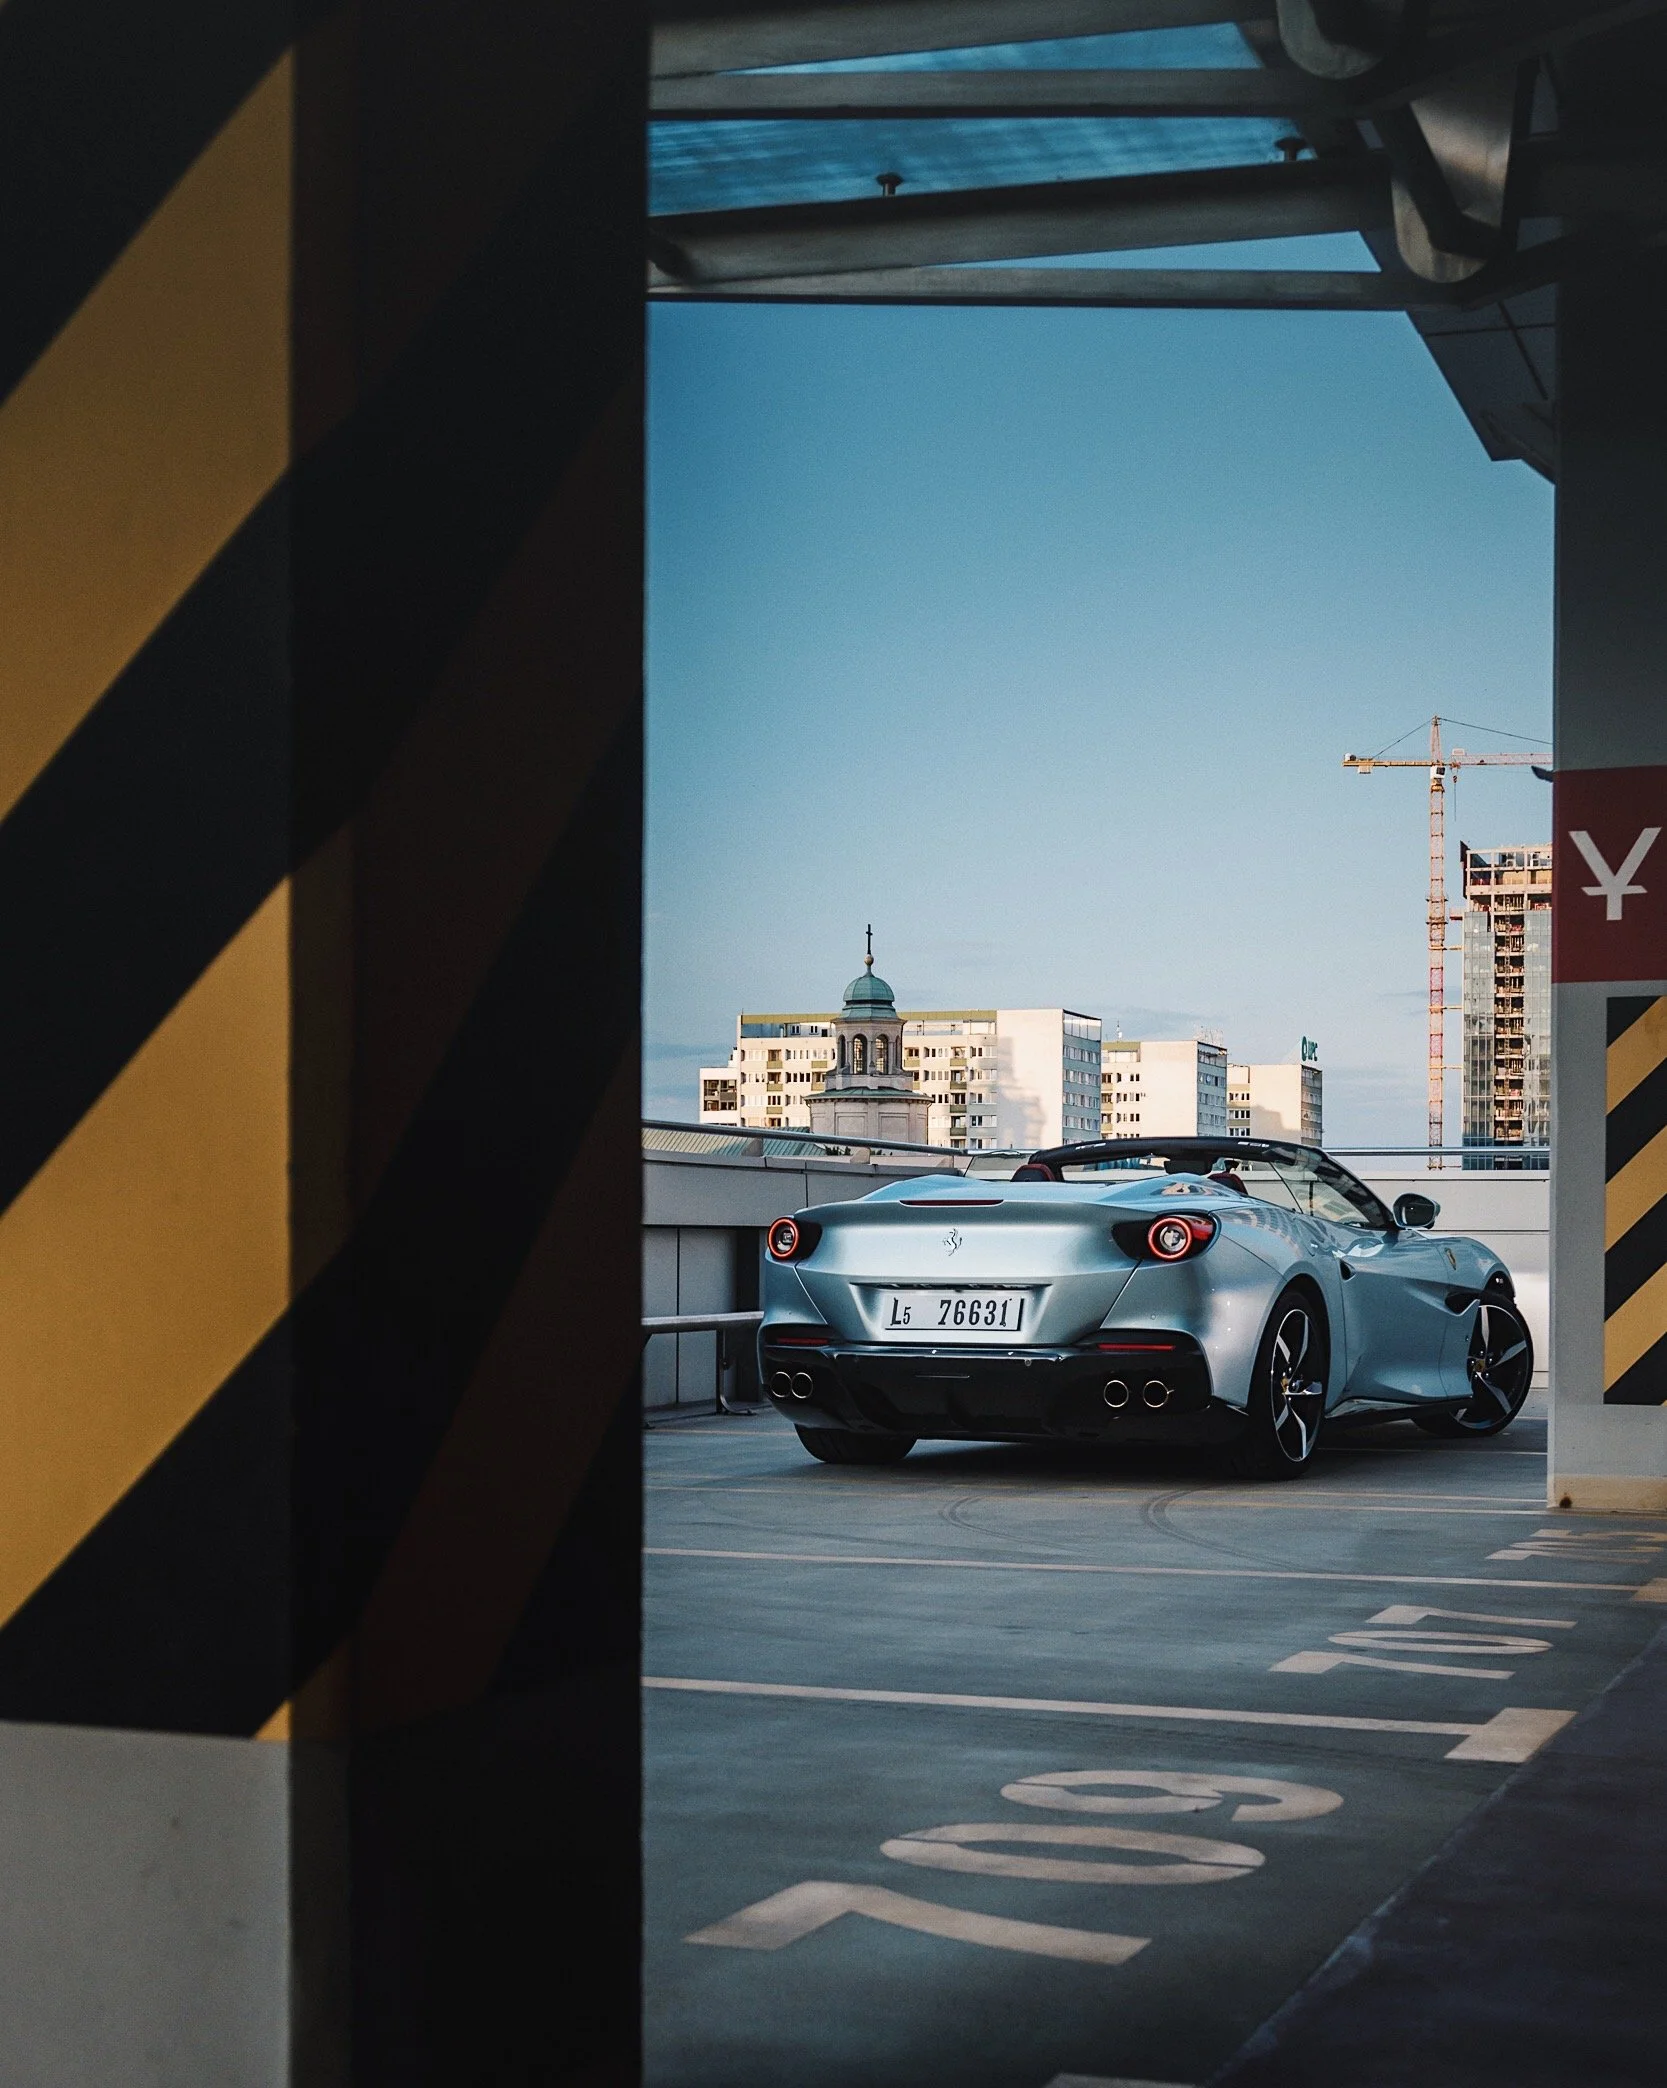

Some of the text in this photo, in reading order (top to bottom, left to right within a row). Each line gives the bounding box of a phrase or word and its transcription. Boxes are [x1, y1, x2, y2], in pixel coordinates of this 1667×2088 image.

[938, 1299, 1009, 1327] 76631
[1267, 1604, 1578, 1680] 707
[682, 1769, 1344, 1966] 709
